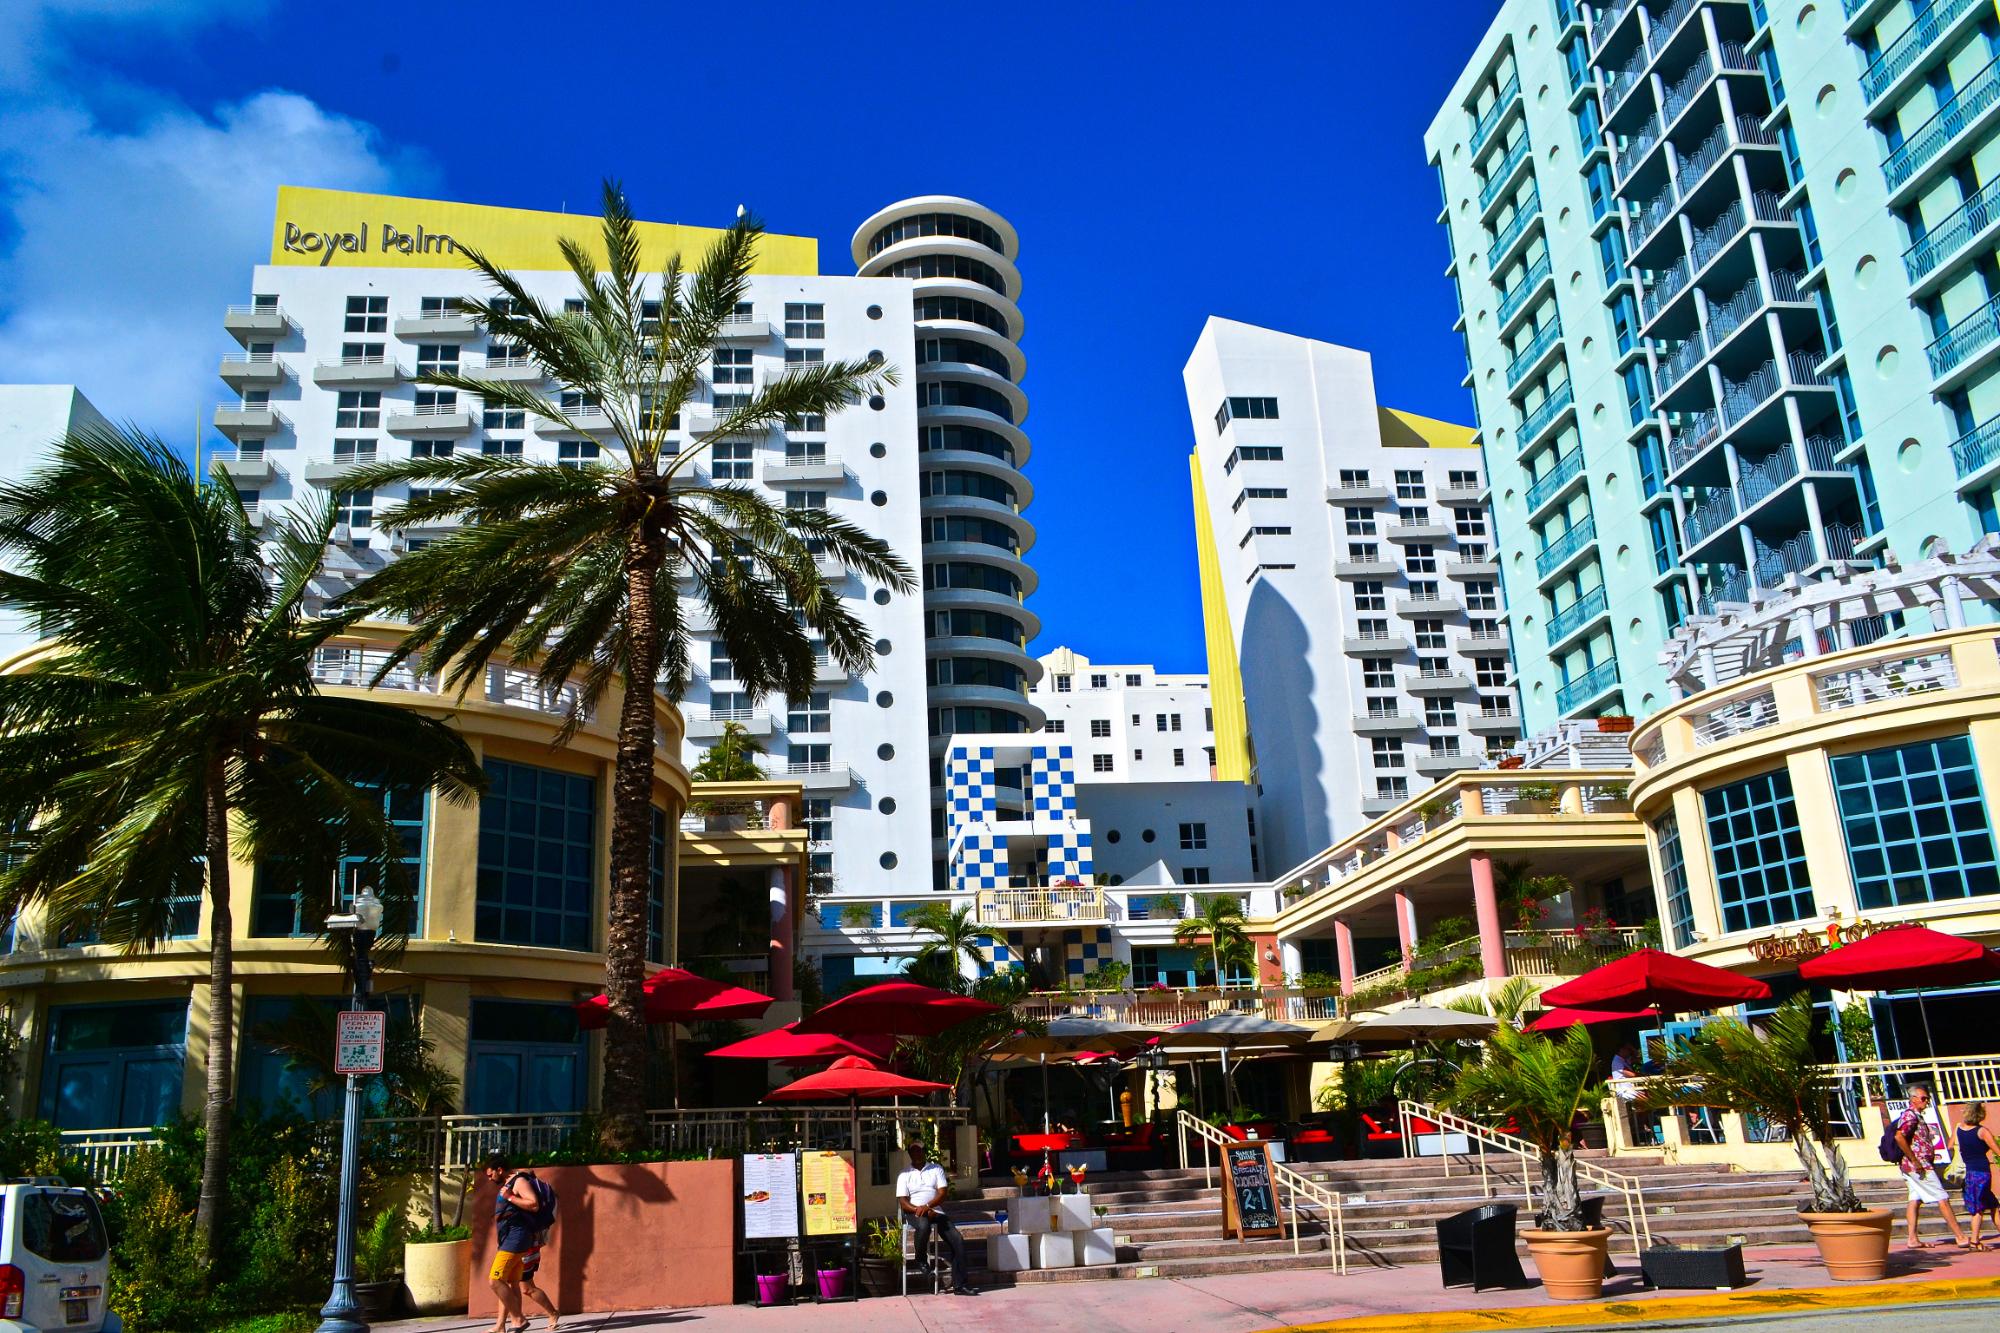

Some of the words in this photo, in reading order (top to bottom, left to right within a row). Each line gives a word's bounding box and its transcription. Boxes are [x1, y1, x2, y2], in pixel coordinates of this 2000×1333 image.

[284, 222, 368, 266] Royal
[381, 224, 455, 254] Palm
[1747, 928, 1823, 965] Tequila
